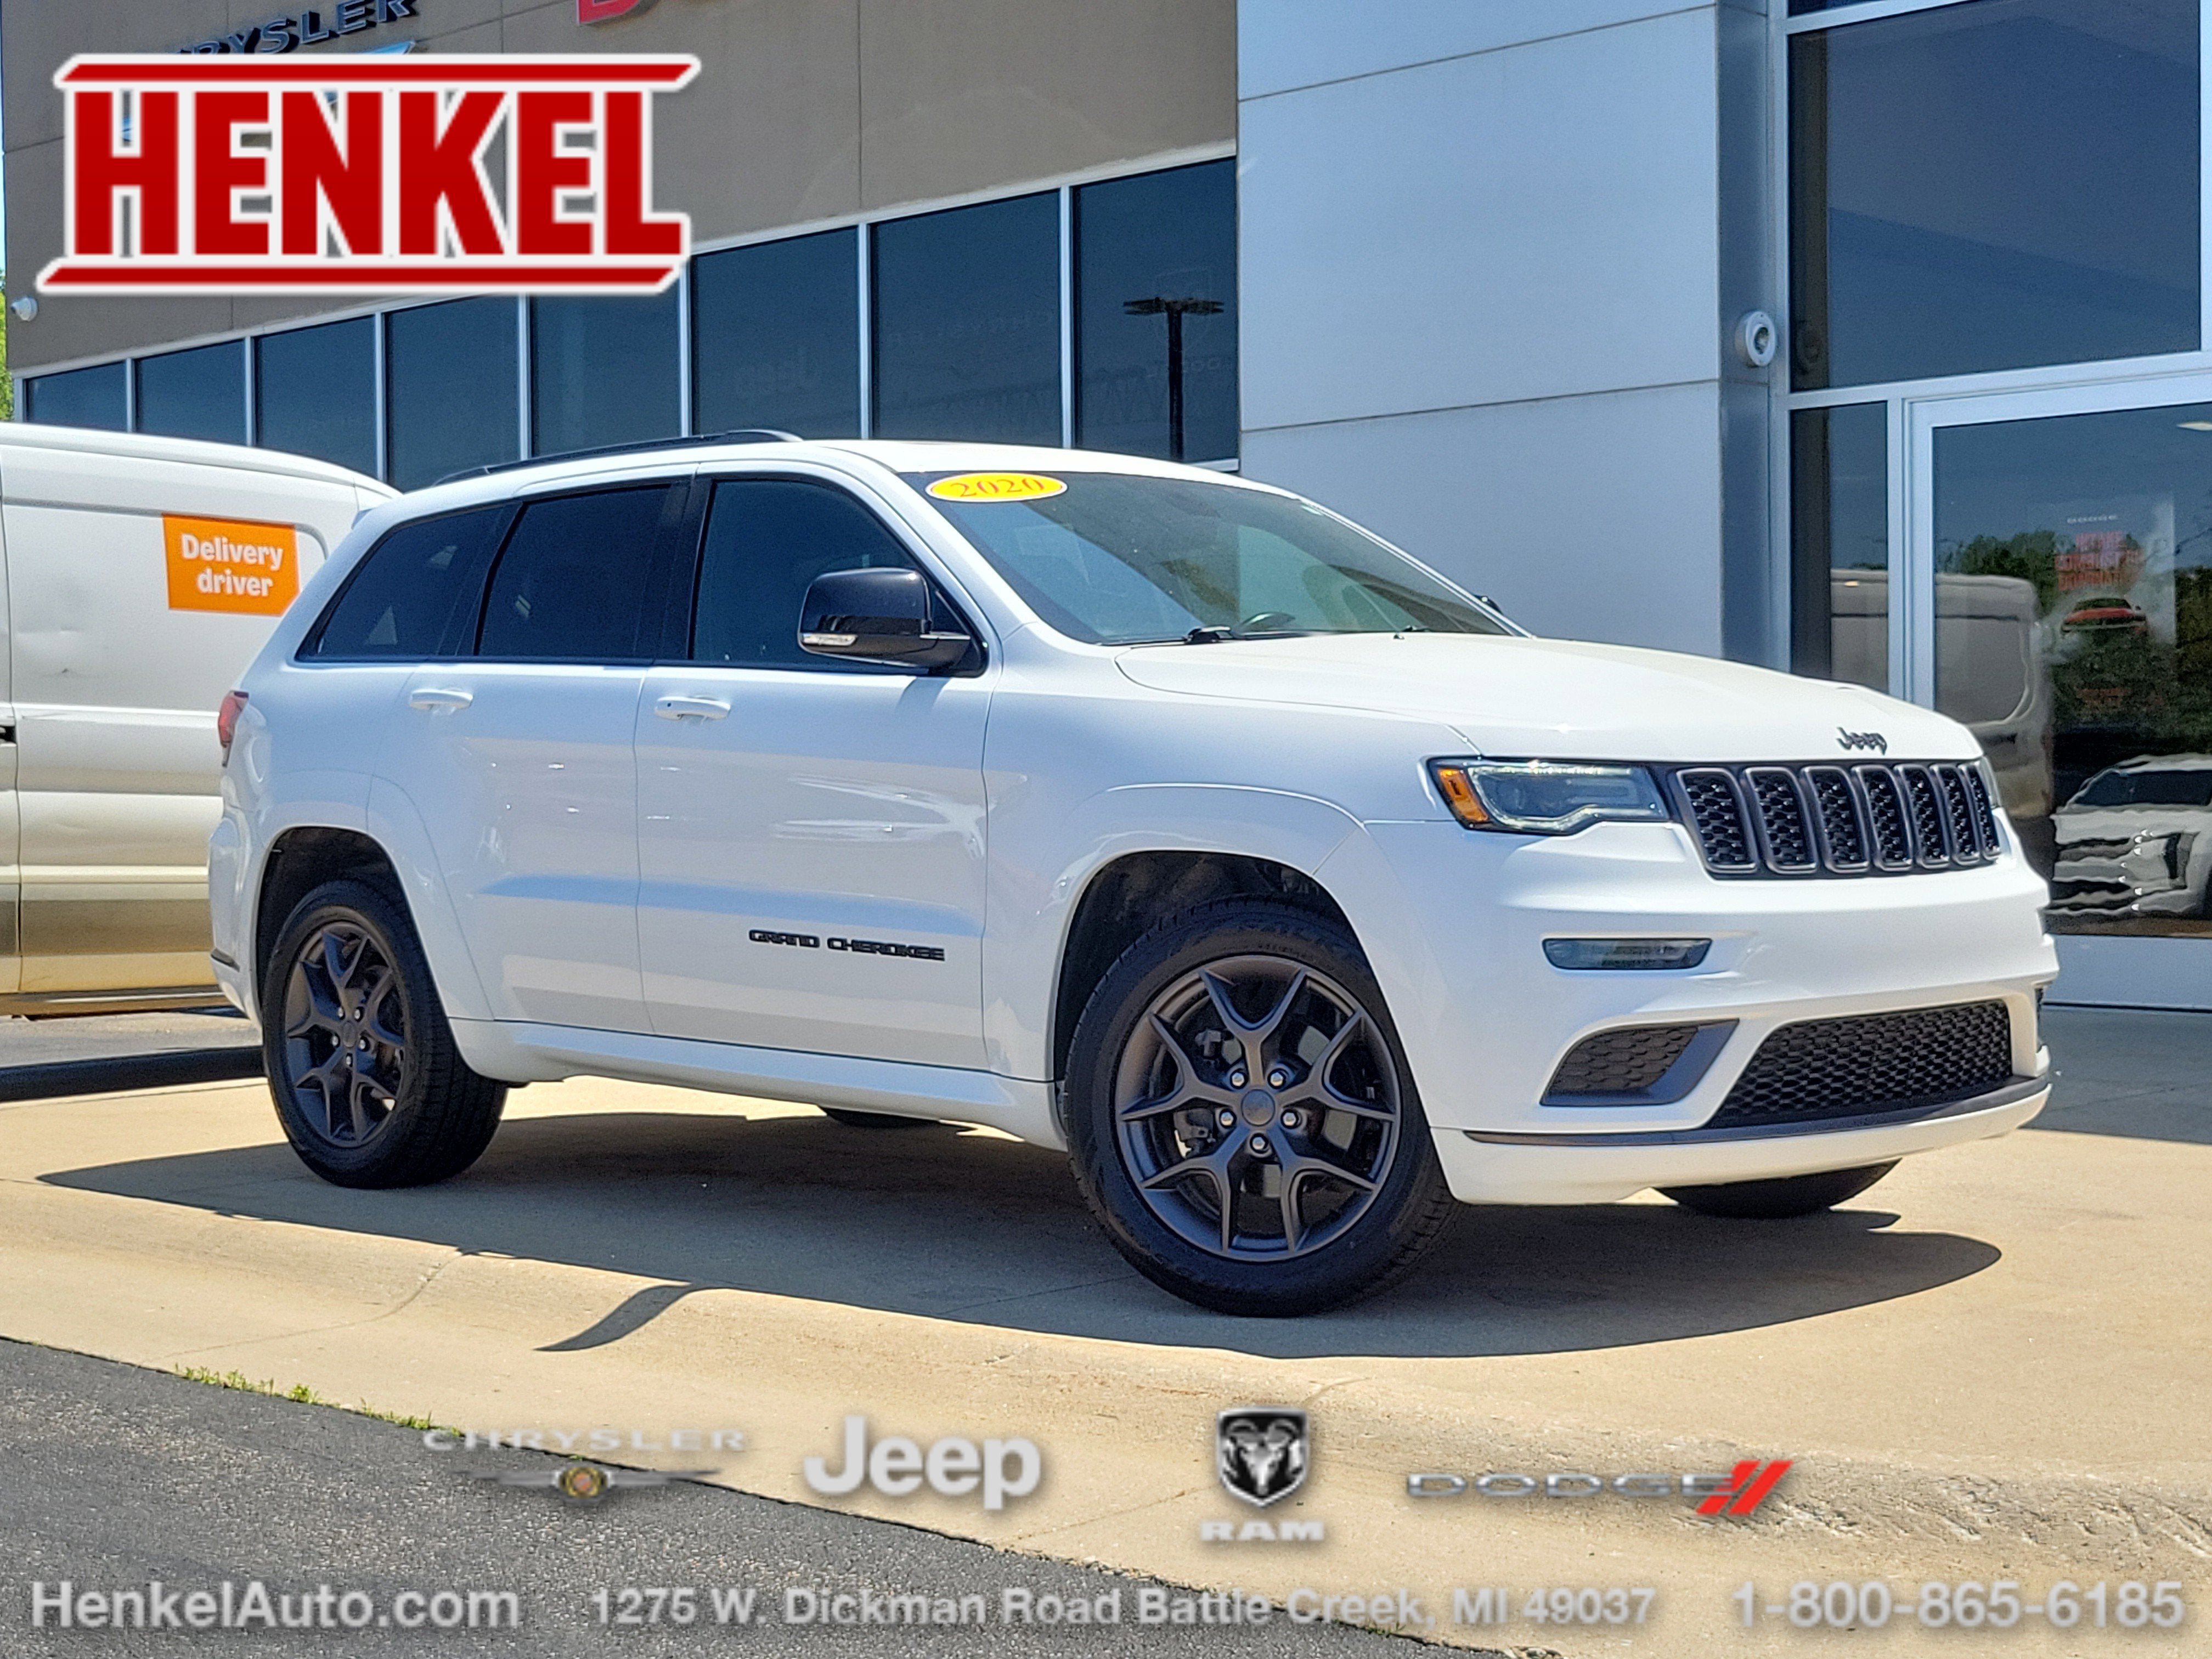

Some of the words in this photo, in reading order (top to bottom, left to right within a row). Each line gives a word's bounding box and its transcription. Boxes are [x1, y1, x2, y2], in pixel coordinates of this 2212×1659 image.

[951, 477, 1045, 498] 2020
[182, 533, 283, 571] Delivery
[198, 567, 273, 597] driver
[1836, 726, 1887, 755] Jeep
[748, 929, 820, 949] GRAND
[827, 936, 945, 962] CHEROKEE
